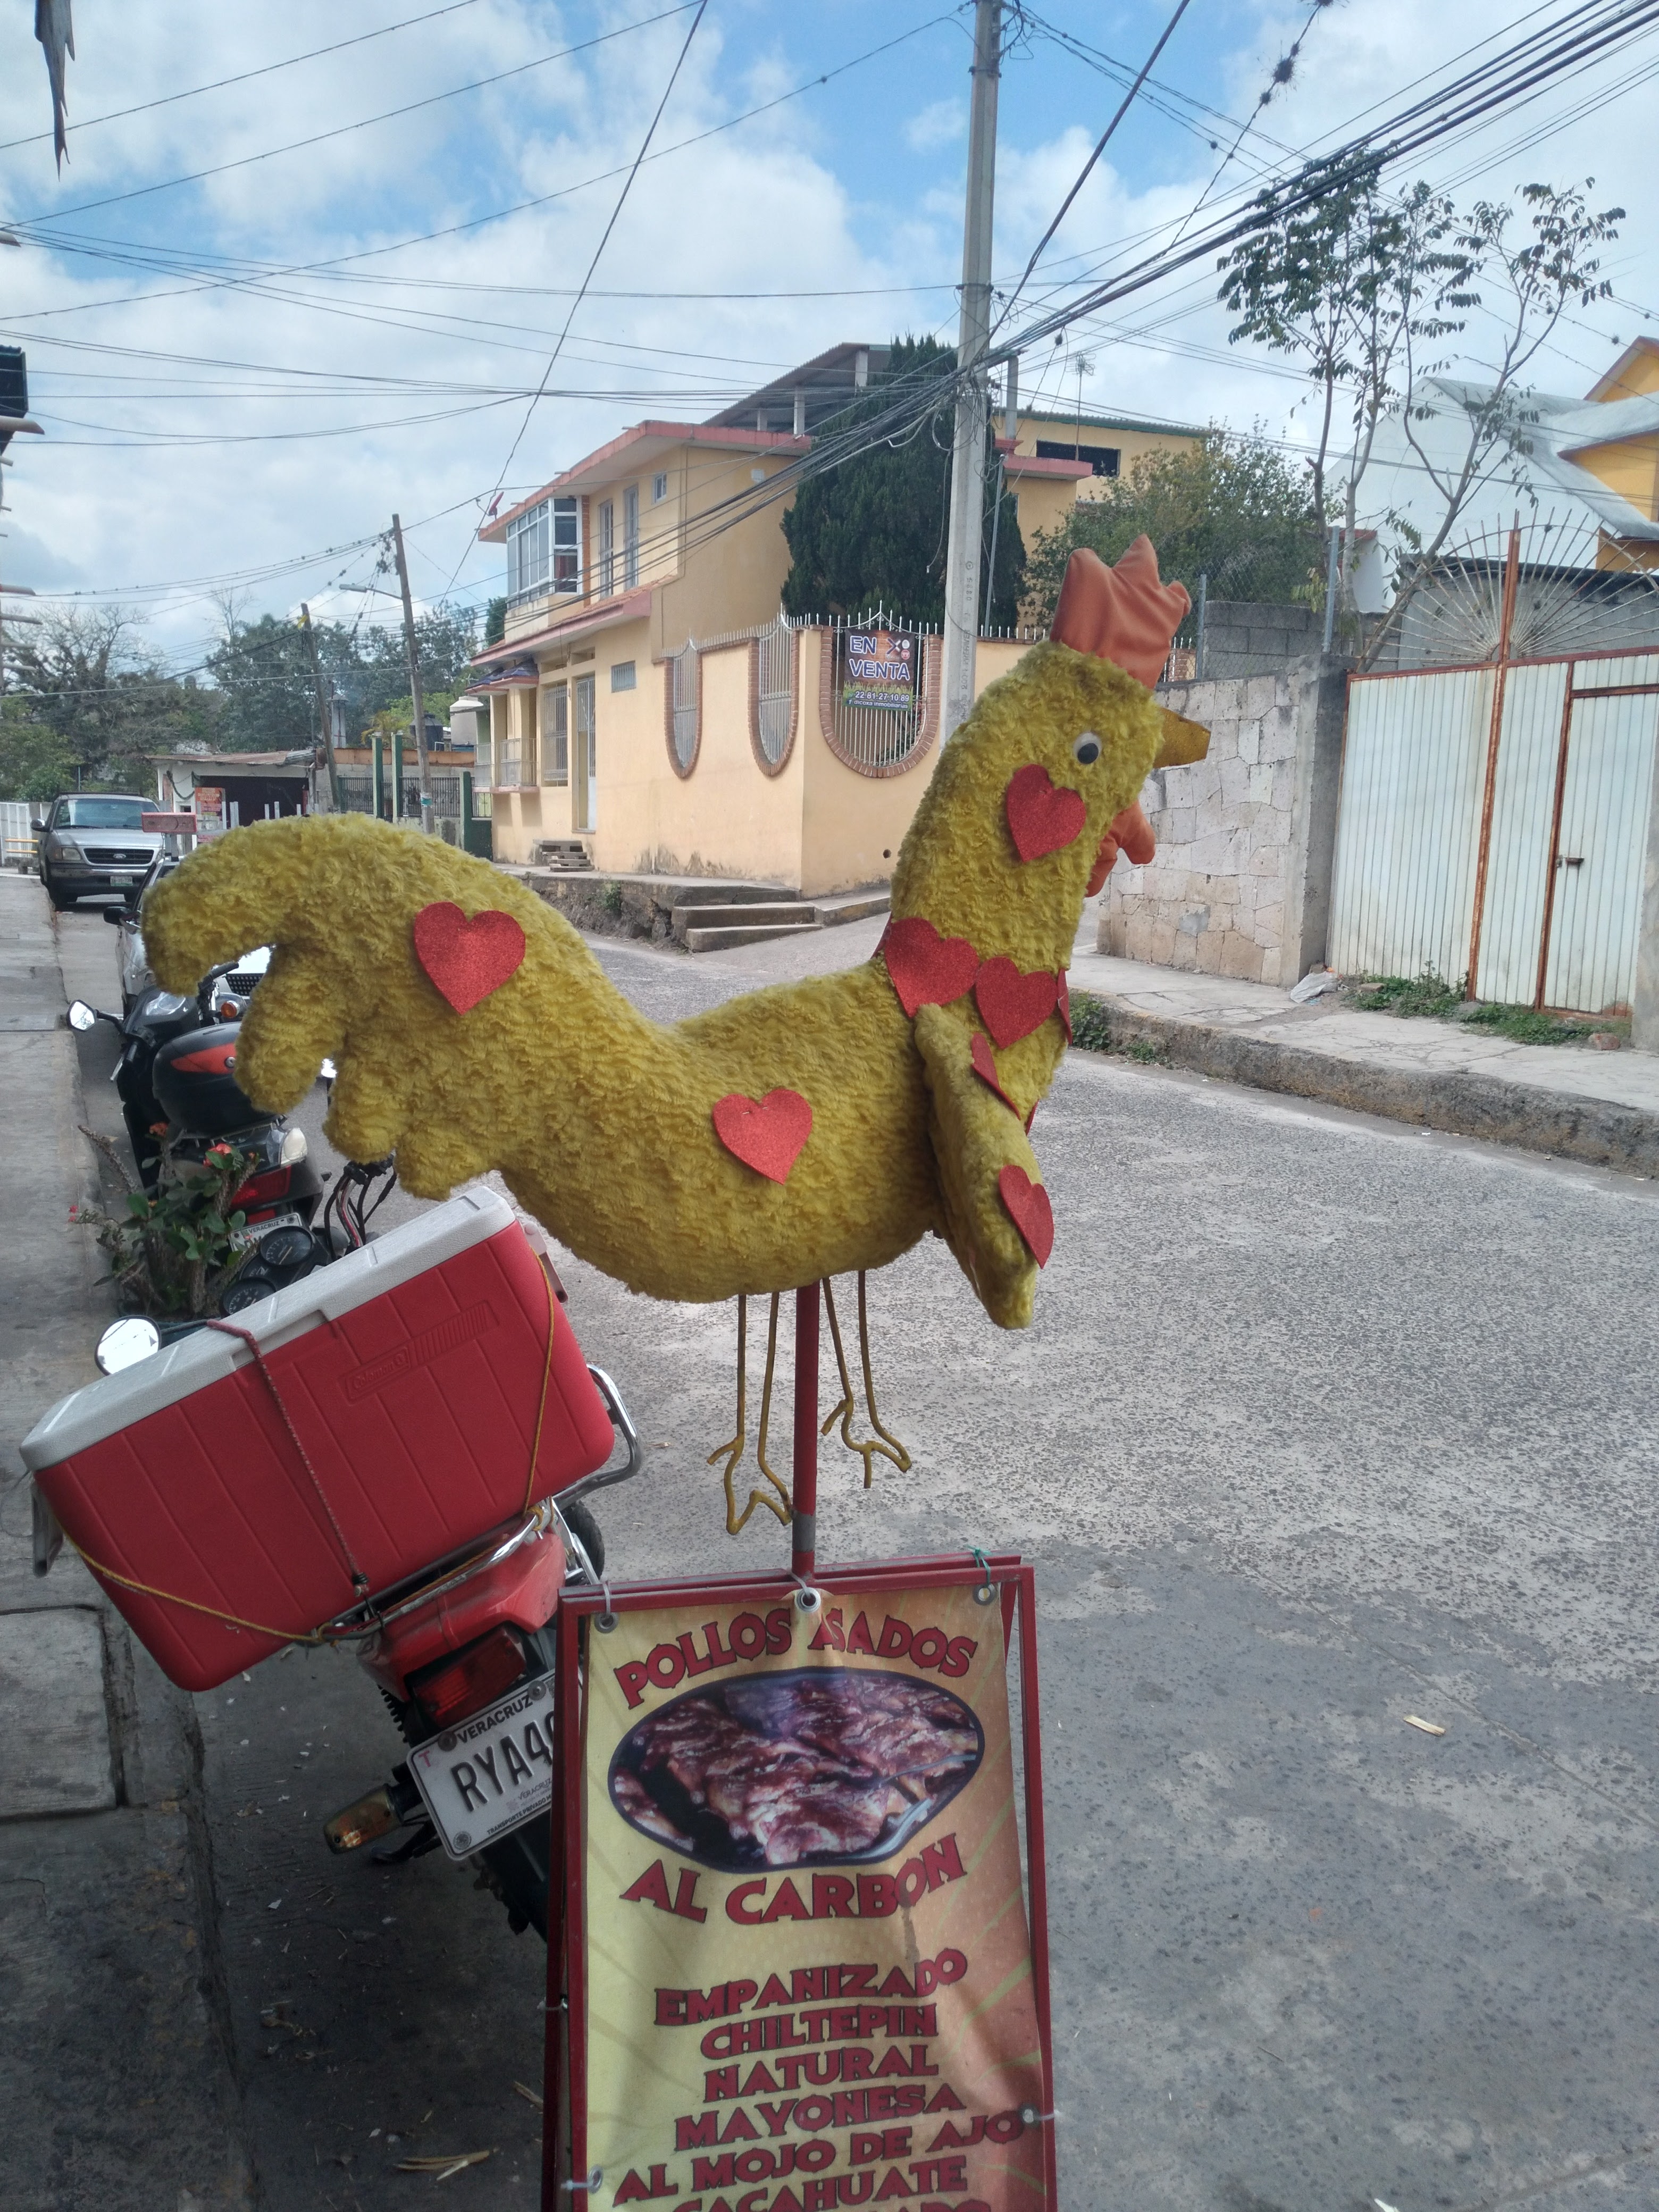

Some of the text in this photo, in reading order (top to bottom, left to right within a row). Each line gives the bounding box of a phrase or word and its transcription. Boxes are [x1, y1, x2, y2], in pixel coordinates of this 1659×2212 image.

[849, 659, 910, 681] VENTA
[850, 636, 876, 655] EN
[248, 1221, 280, 1233] VERACRUZ
[614, 1608, 978, 1710] POLLOS ASADOS
[457, 1695, 533, 1744] VERACRUZ
[487, 1798, 546, 1834] TRANSPORTE PRIVADO
[518, 1778, 552, 1800] VERACRUZ
[619, 1833, 967, 1925] AL CARBON
[654, 1949, 967, 2026] EMPANIZADO
[700, 2002, 937, 2060] CHILTEPIN
[703, 2045, 939, 2104] NATURAL
[674, 2083, 967, 2152] MAYONESA
[612, 2110, 1024, 2208] AL MOJO DE AJO
